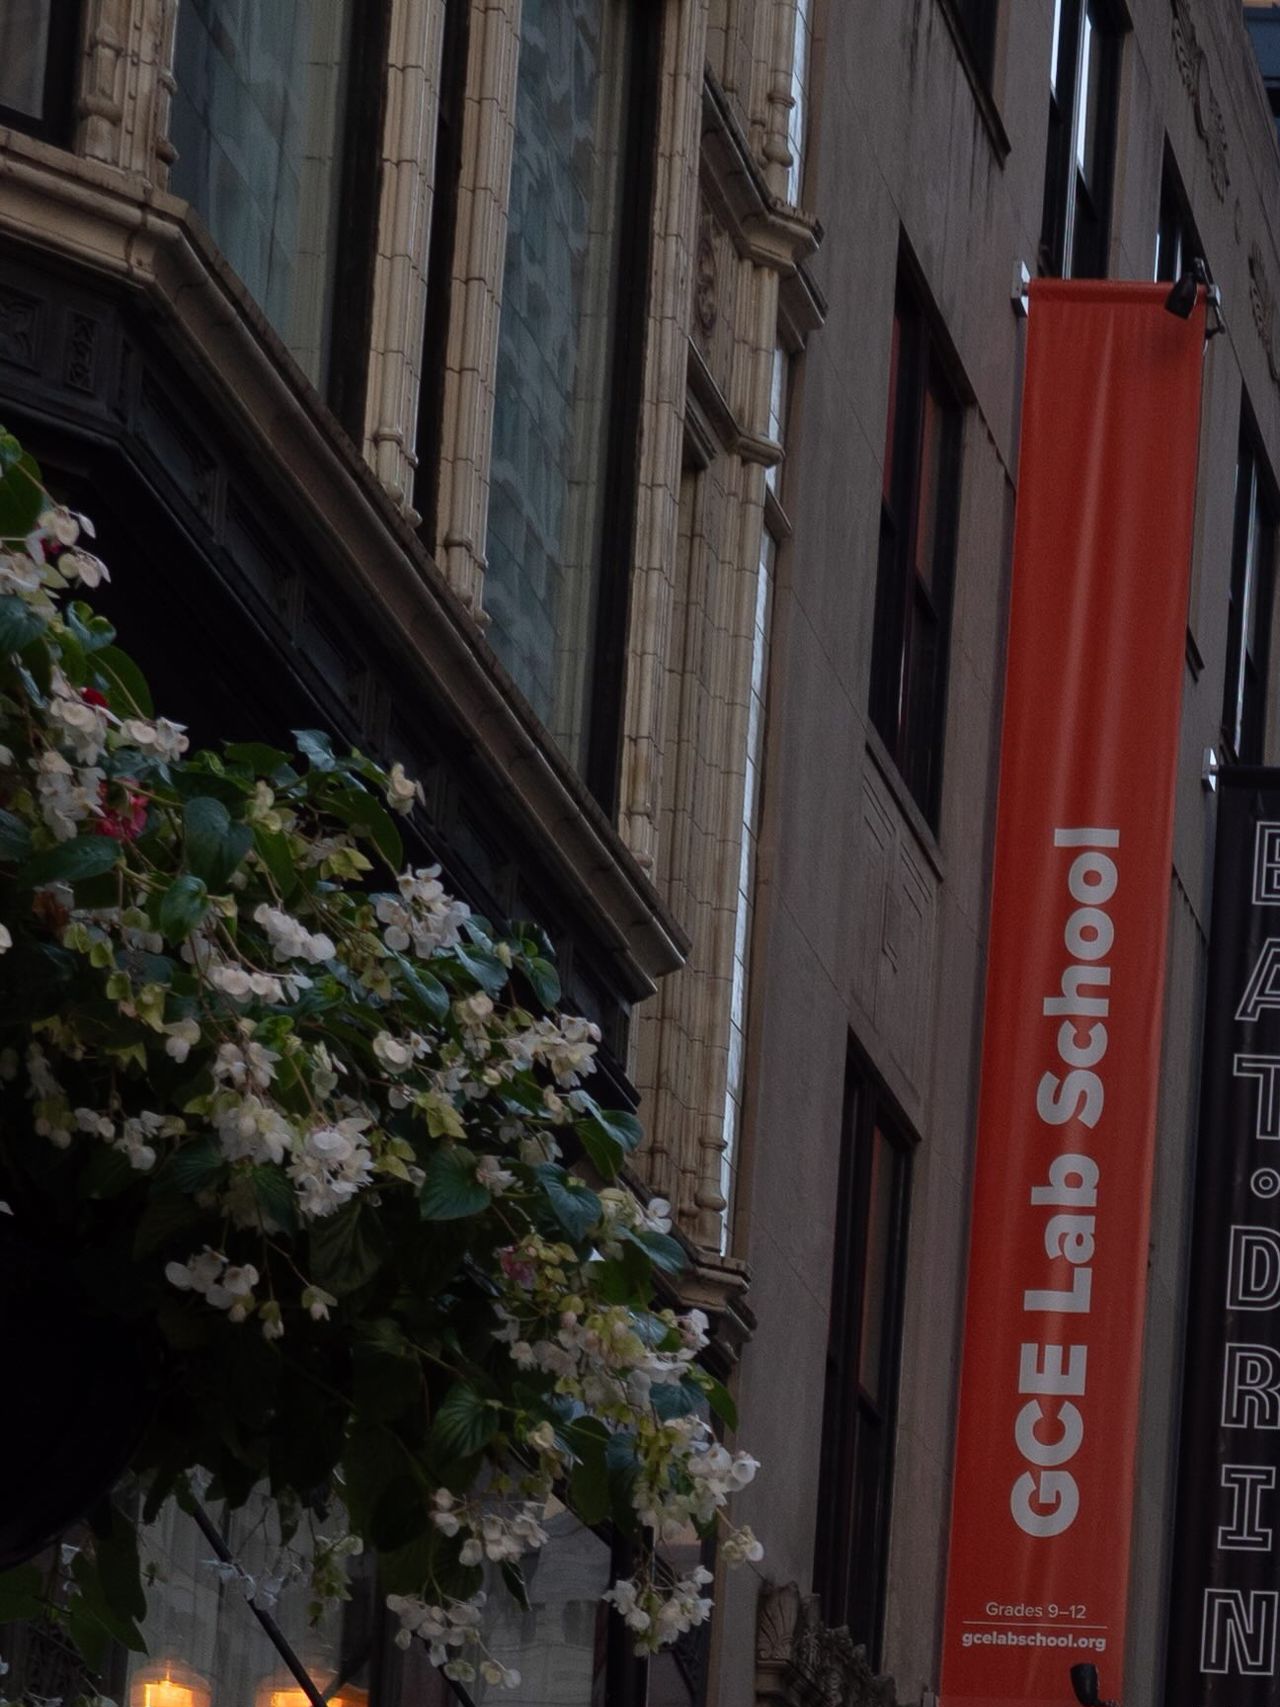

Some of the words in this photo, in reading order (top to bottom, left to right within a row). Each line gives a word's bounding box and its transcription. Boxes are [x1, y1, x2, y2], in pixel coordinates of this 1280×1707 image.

[1035, 827, 1121, 1130] School
[1023, 1154, 1101, 1315] Lab
[1010, 1341, 1088, 1538] GCE
[961, 1630, 1108, 1652] gcelabschool.org
[985, 1600, 1044, 1618] Grades
